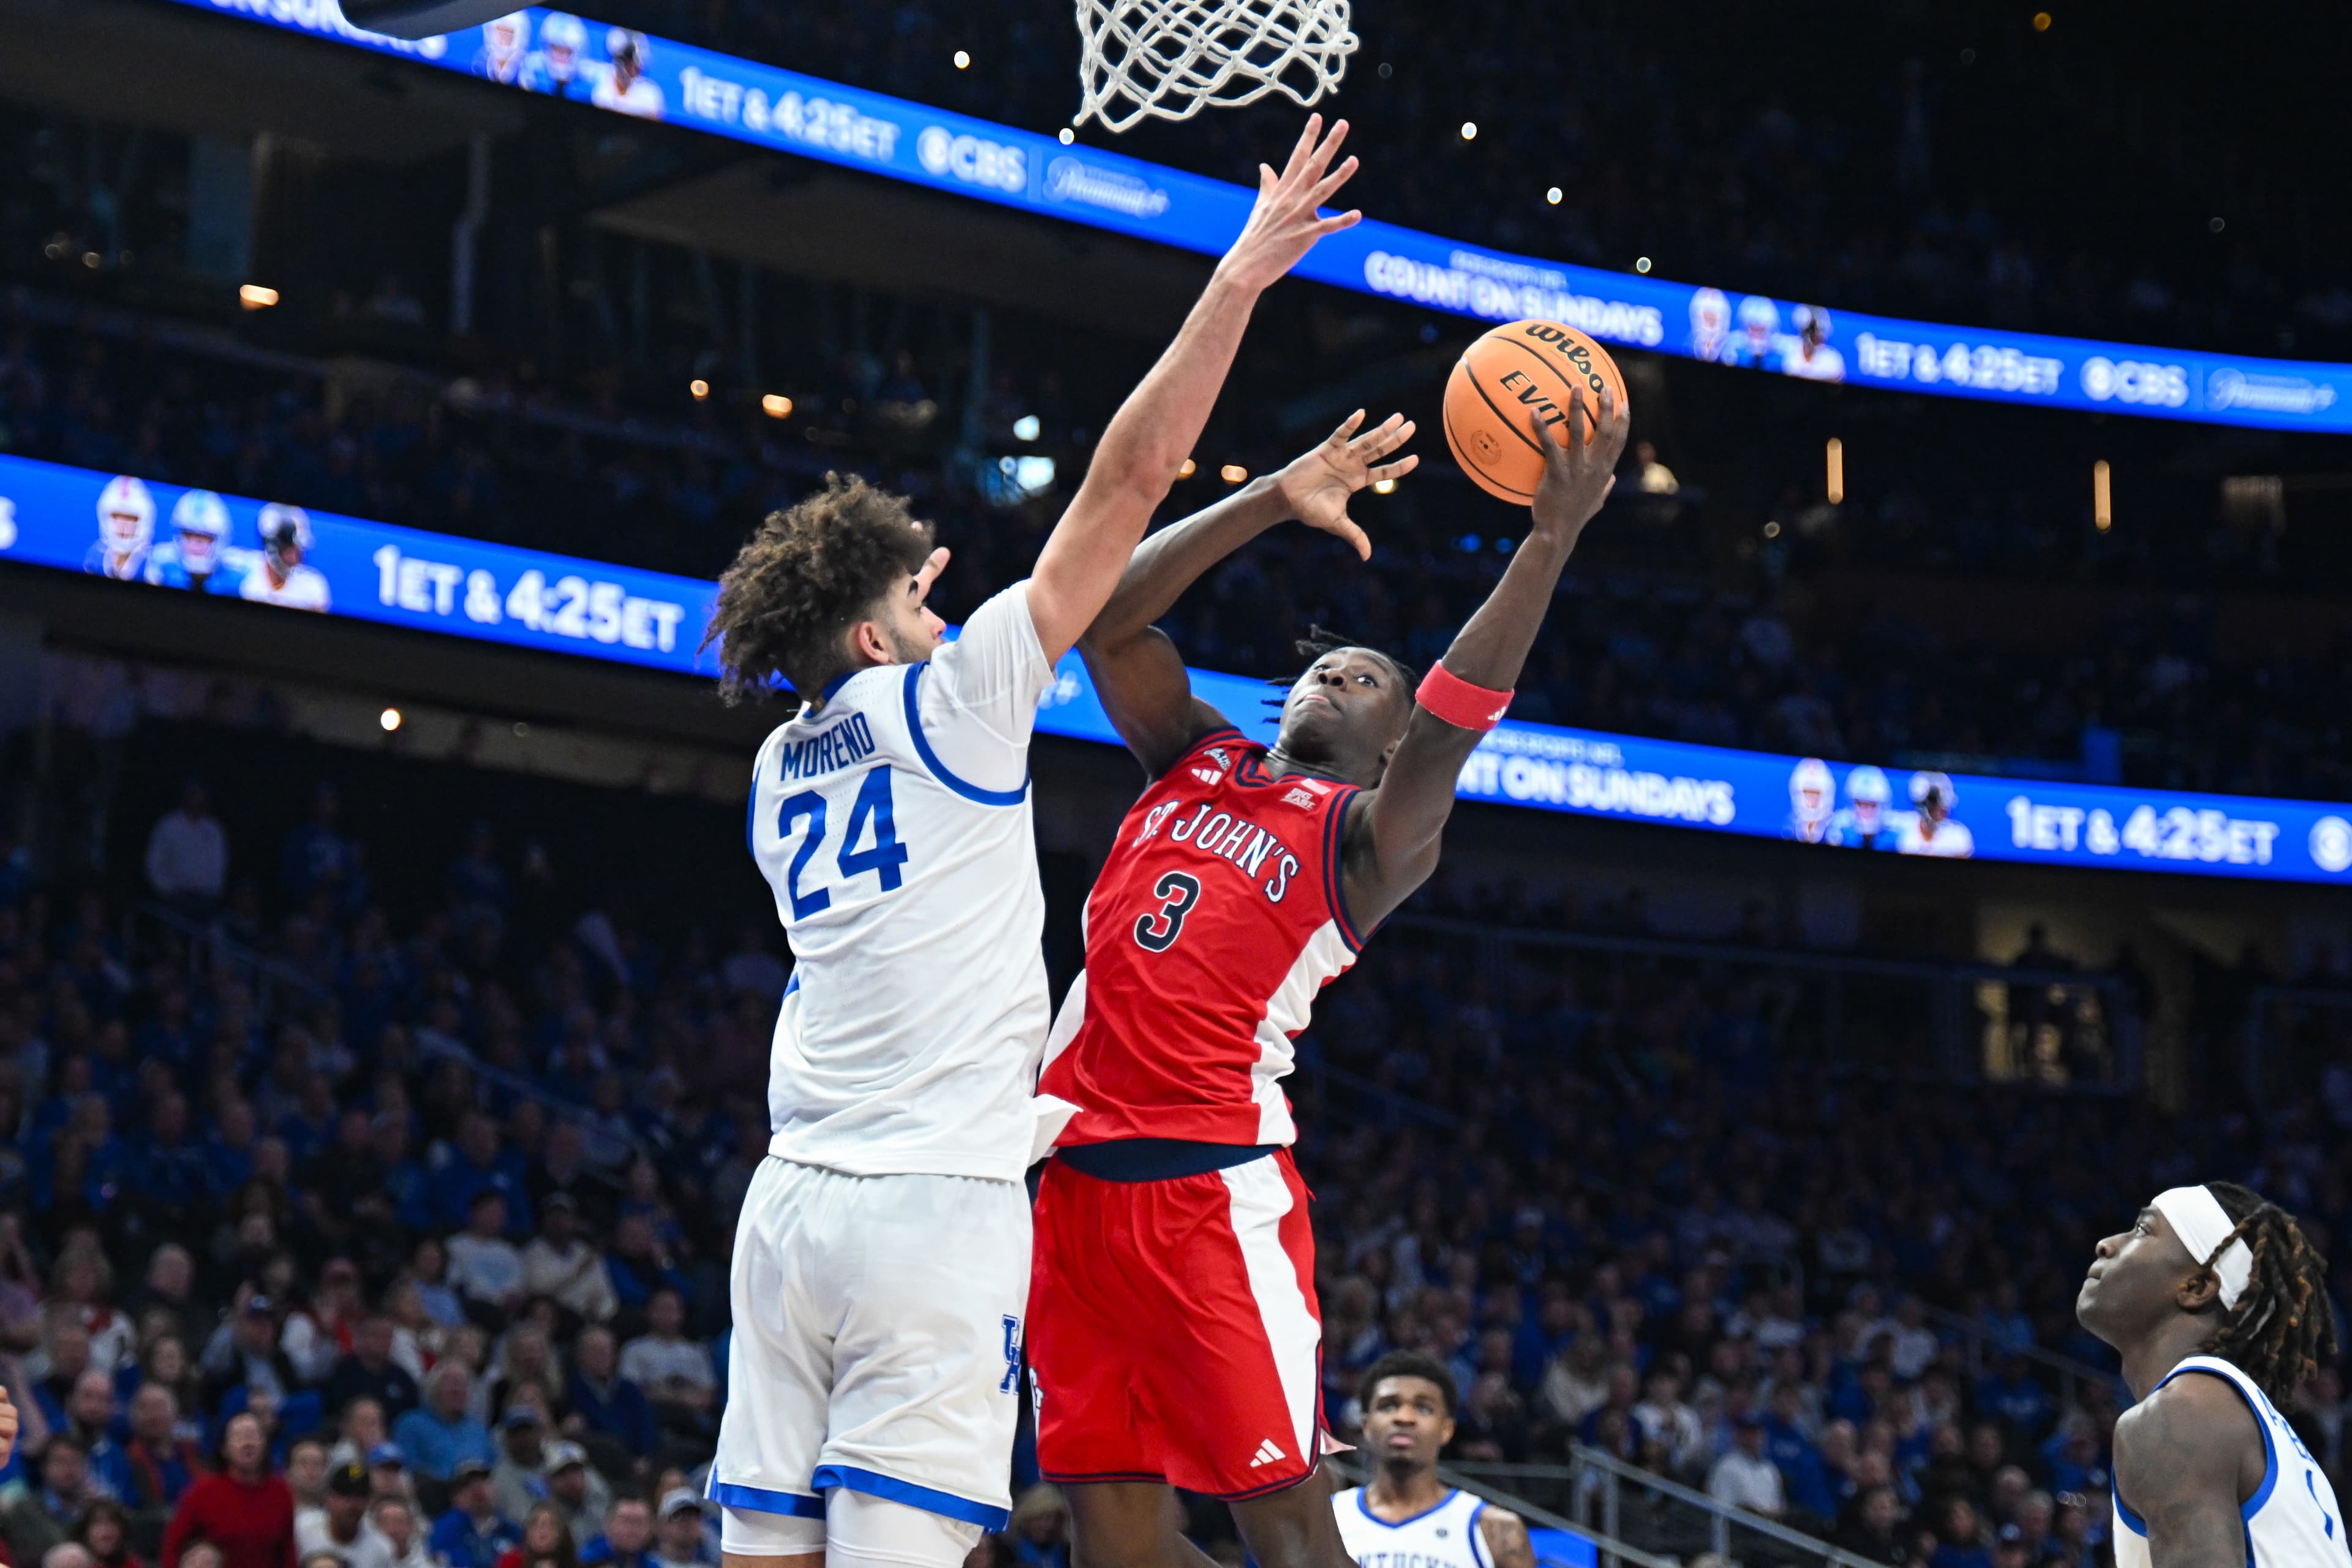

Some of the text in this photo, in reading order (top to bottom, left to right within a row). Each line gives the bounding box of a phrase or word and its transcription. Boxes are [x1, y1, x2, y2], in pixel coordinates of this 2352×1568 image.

[742, 88, 771, 132] &
[949, 135, 1027, 194] CBS
[1364, 251, 1470, 310] COUNT
[1470, 275, 1520, 321] ON
[1519, 285, 1664, 347] SUNDAYS
[1526, 324, 1604, 398] Wilso
[2114, 360, 2189, 408] CBS
[373, 545, 685, 652] 1ET & 4:25ET
[780, 712, 875, 782] MORENO
[1565, 761, 1736, 826] SUNDAYS
[2005, 795, 2086, 851] 1ET
[2085, 809, 2120, 855] &
[778, 763, 908, 922] 24
[1170, 803, 1301, 903] JOHN'S
[1133, 870, 1202, 954] 3
